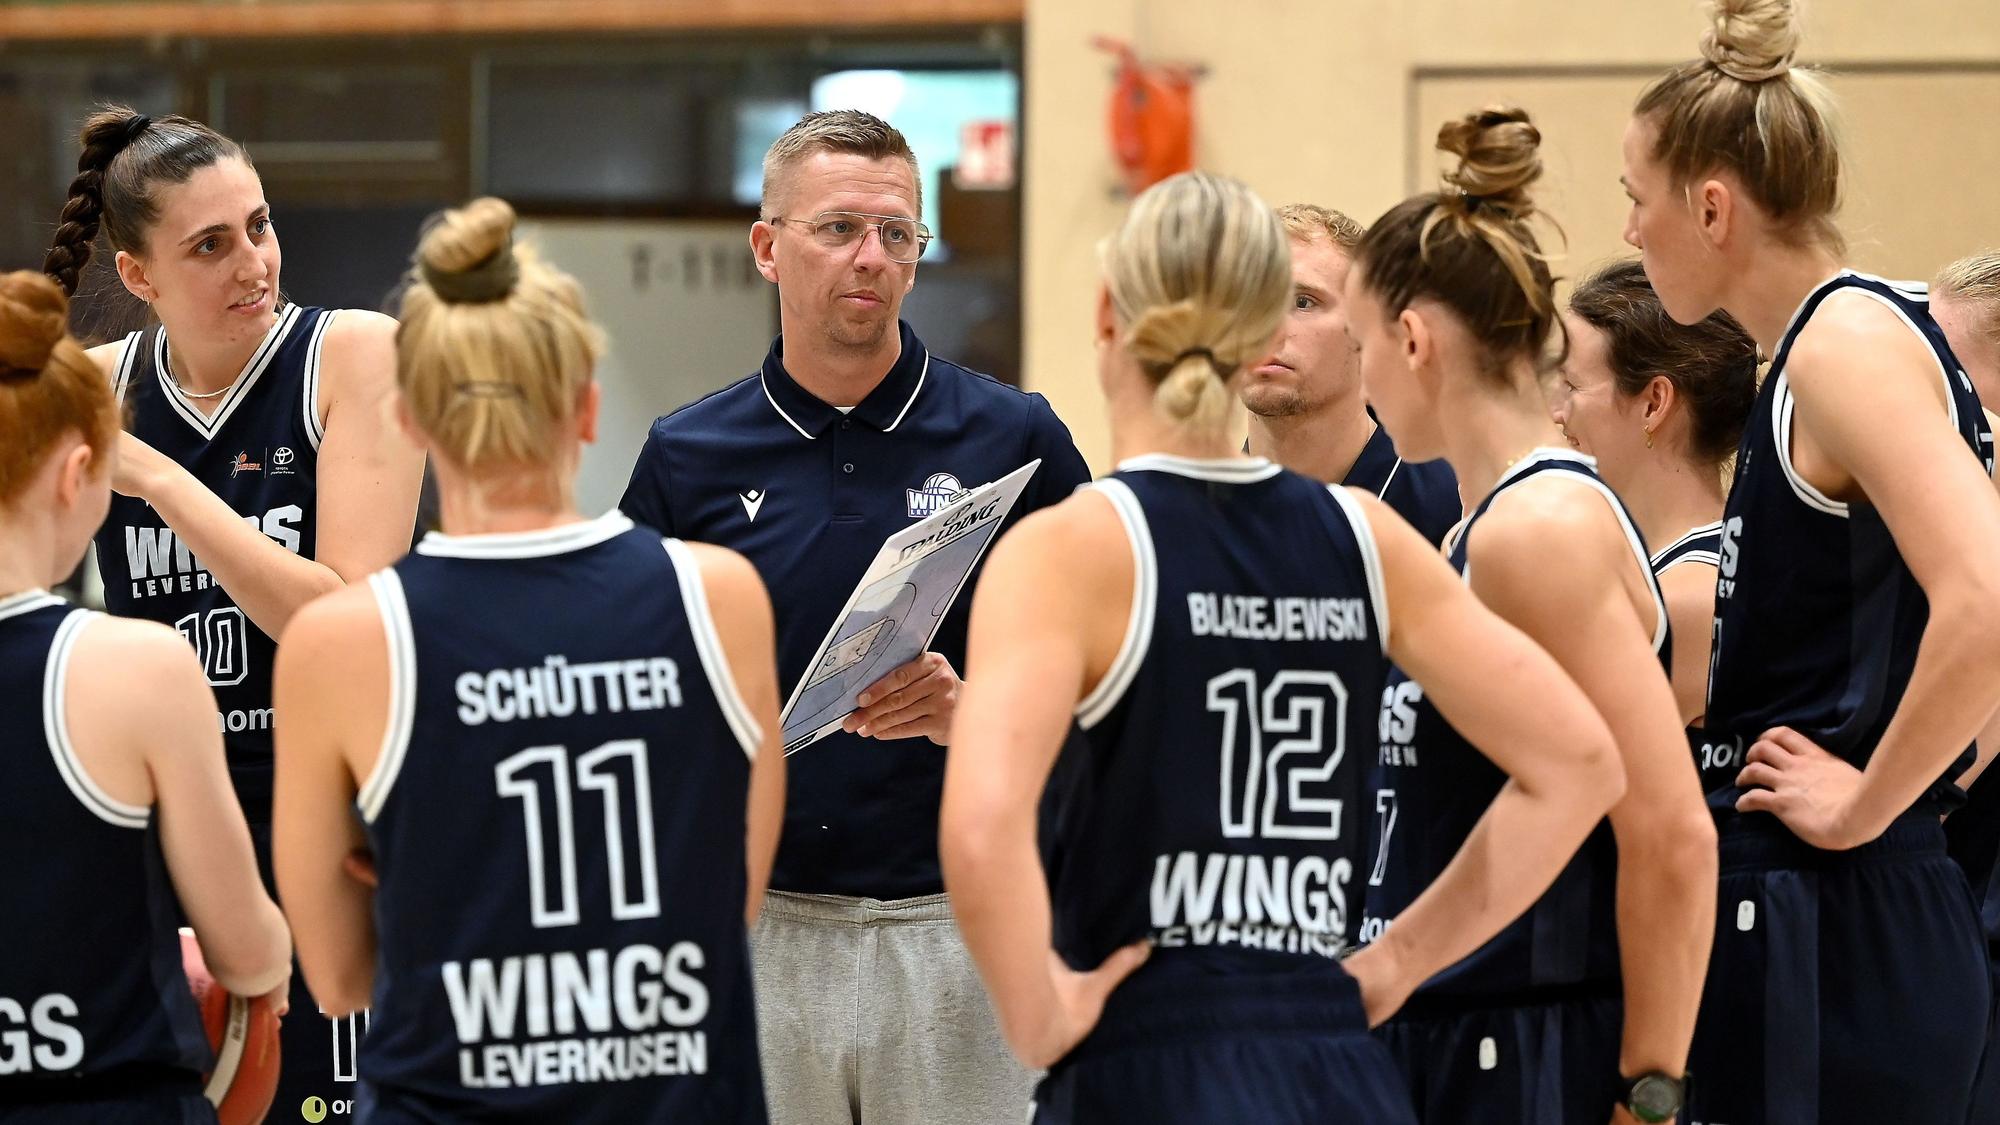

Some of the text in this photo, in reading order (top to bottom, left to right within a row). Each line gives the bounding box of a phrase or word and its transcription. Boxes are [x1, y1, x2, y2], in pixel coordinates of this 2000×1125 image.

[125, 504, 303, 580] WIS
[890, 496, 1002, 569] SPALDING
[1719, 516, 1743, 578] S
[1187, 592, 1367, 642] BLAZEJEWSKI
[455, 654, 683, 726] SCHÜTTER
[1206, 668, 1348, 841] 12
[495, 738, 661, 929] 11
[1151, 852, 1352, 936] WINGS
[441, 941, 710, 1044] WINGS
[459, 1030, 709, 1088] LEVERKUSEN
